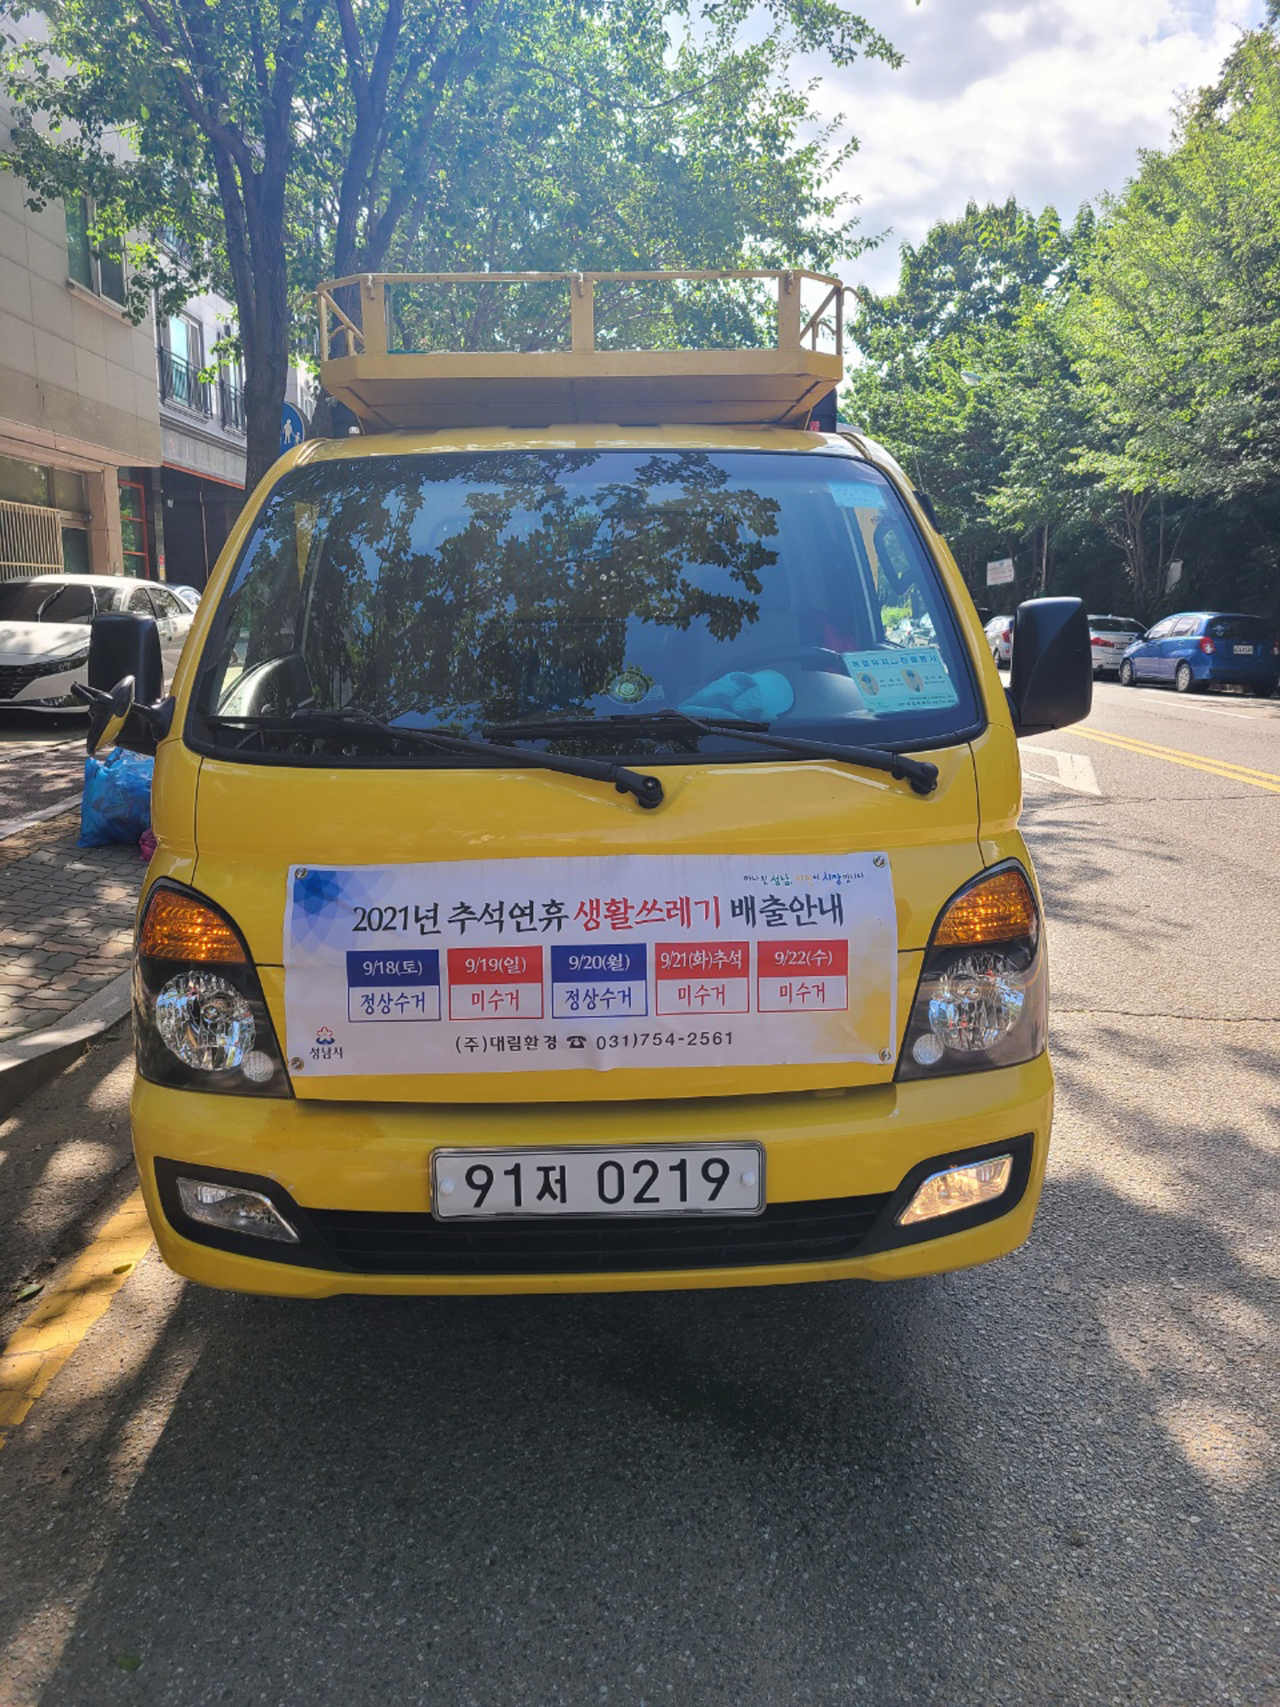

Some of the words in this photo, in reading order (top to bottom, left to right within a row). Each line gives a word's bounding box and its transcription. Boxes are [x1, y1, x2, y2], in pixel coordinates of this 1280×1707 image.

[352, 902, 441, 936] 2021년
[447, 899, 569, 935] 추석연휴
[573, 896, 721, 931] 생활쓰레기
[730, 892, 844, 928] 배출안내
[362, 961, 423, 976] 9/18(토)
[465, 957, 527, 974] 9/19(일)
[568, 953, 630, 971] 9/20(월)
[660, 950, 743, 970] 9/21(화)추석
[774, 950, 833, 967] 9/22(수)
[360, 992, 426, 1014] 정상수거
[471, 989, 520, 1012] 미수거
[565, 987, 632, 1010] 정상수거
[677, 984, 726, 1007] 미수거
[779, 982, 826, 1004] 미수거
[455, 1035, 558, 1053] (주)대림환경
[596, 1031, 733, 1050] 031)754-2561
[310, 1047, 343, 1060] 성남시
[465, 1158, 567, 1208] 91저
[597, 1157, 731, 1204] 0219
